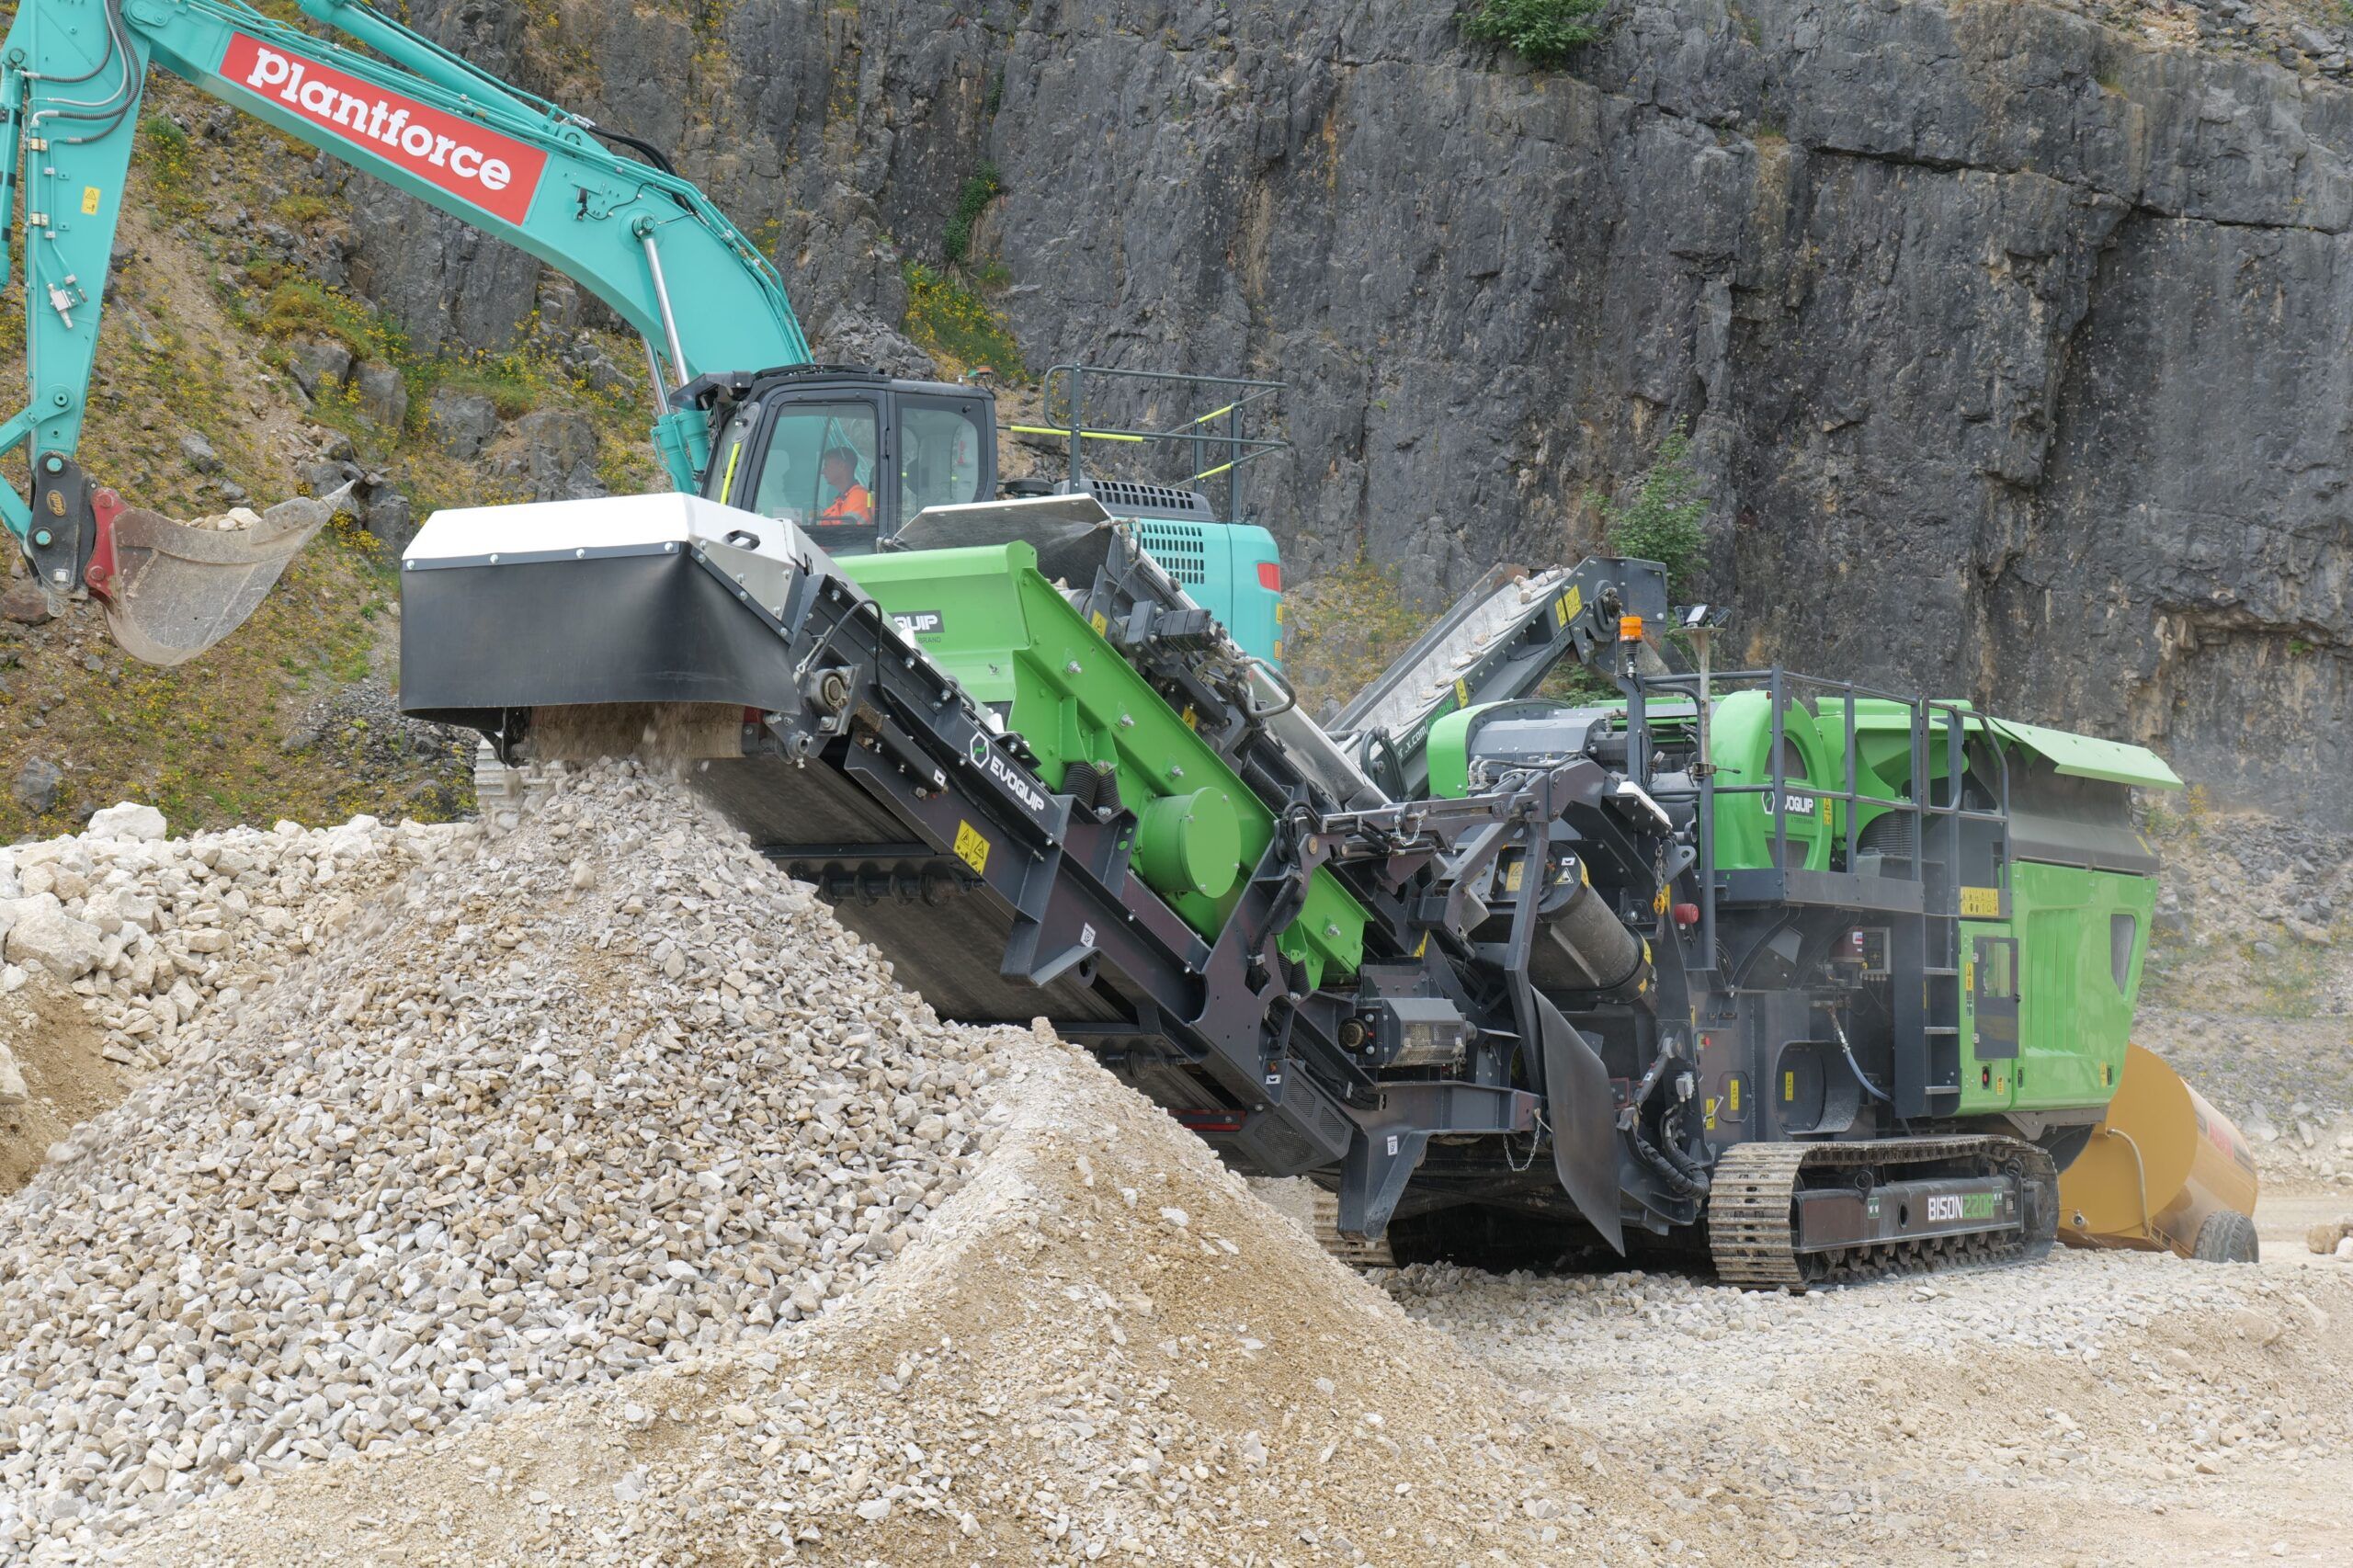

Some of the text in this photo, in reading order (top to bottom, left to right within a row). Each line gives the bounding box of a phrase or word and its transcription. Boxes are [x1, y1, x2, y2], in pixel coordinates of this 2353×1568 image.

[246, 47, 511, 190] plantforce
[893, 614, 938, 631] QUIP
[990, 755, 1045, 812] EVOQUIP
